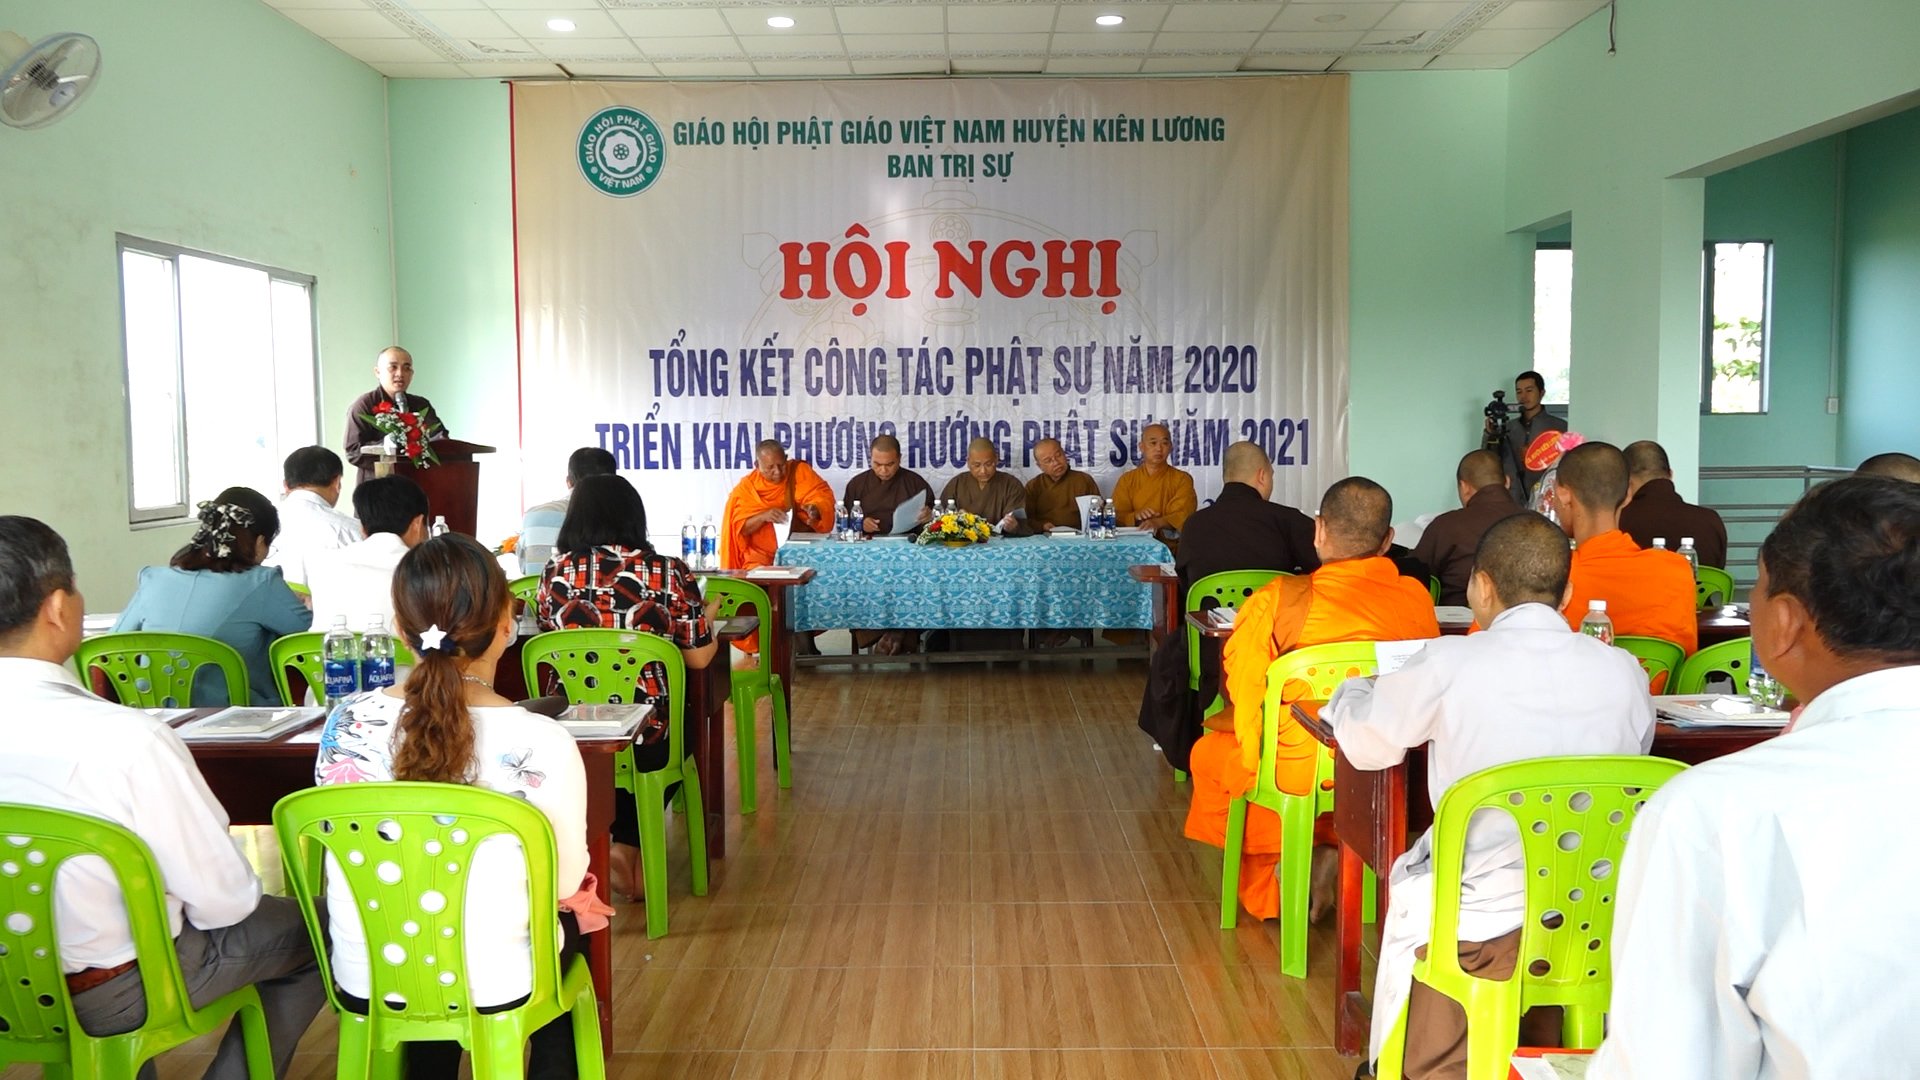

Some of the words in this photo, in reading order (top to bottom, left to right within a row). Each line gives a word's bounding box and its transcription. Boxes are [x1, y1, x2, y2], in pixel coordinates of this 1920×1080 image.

[583, 134, 597, 164] GIÁO
[594, 117, 614, 133] HỘI
[616, 115, 648, 132] PHẬT
[645, 133, 659, 163] GIÁO
[673, 117, 725, 146] GIÁO
[732, 116, 769, 150] HỘI
[777, 116, 834, 150] PHẬT
[840, 115, 893, 145] GIÁO
[899, 115, 947, 149] VIỆT
[953, 120, 1005, 144] NAM
[1012, 114, 1086, 148] HUYỆN
[1093, 114, 1145, 143] KIÊN
[1152, 116, 1225, 143] LƯƠNG
[599, 173, 620, 189] VIỆT
[622, 173, 646, 188] NAM
[888, 155, 933, 178] BAN
[940, 155, 974, 183] TRỊ
[982, 152, 1014, 183] SỰ
[778, 222, 912, 317] HỘI
[931, 239, 1122, 315] NGHỊ
[649, 328, 729, 397] TỔNG
[739, 332, 795, 397] KẾT
[804, 337, 888, 397] CÔNG
[896, 336, 955, 396] TÁC
[965, 335, 1043, 407] PHẬT
[1052, 340, 1097, 406] SỰ
[1103, 334, 1174, 394] NĂM
[1184, 344, 1258, 394] 2020
[594, 402, 682, 470] TRIỂN
[368, 673, 395, 684] AQUAFIN
